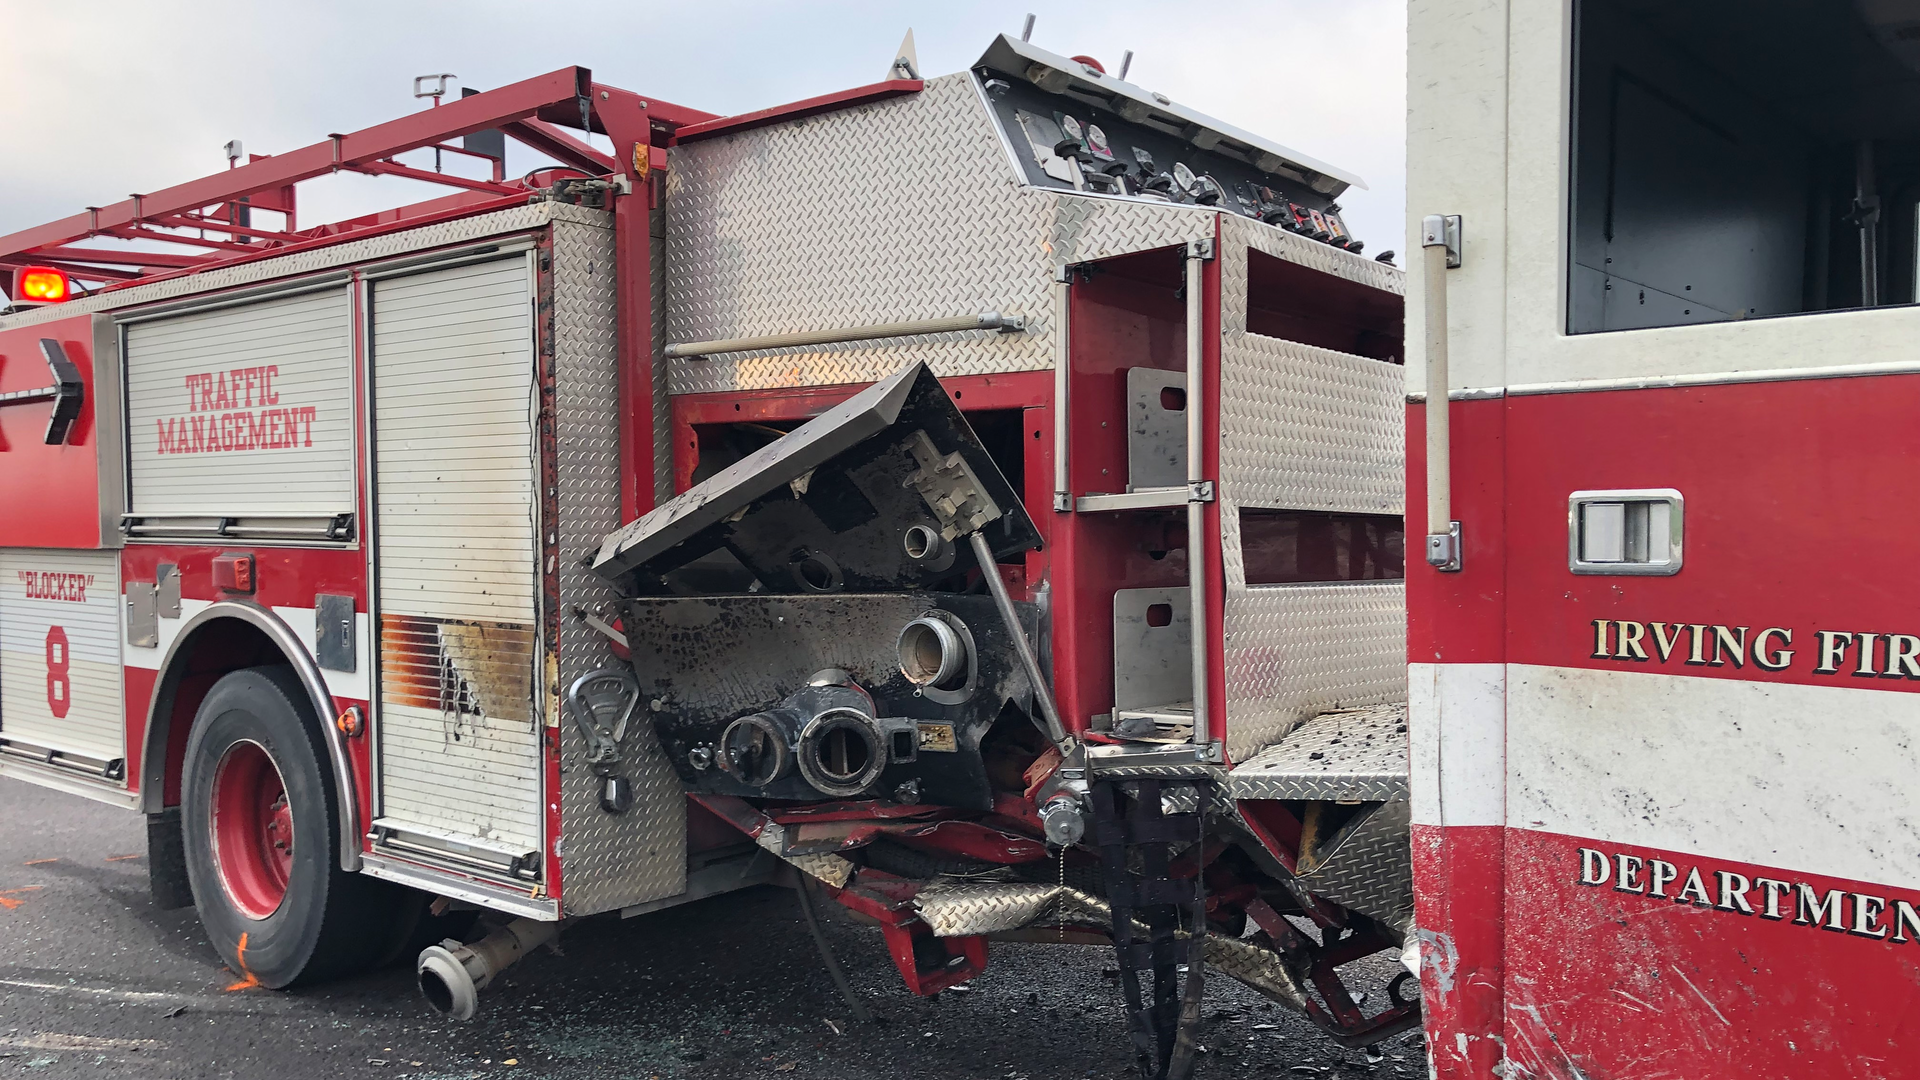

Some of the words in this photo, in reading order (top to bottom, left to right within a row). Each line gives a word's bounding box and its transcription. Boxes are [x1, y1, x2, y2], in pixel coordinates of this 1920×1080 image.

[185, 365, 279, 412] TRAFFIC
[157, 406, 316, 455] MANAGEMENT
[46, 625, 70, 718] 8
[1591, 619, 1795, 671] IRVING
[1813, 630, 1920, 681] FIR
